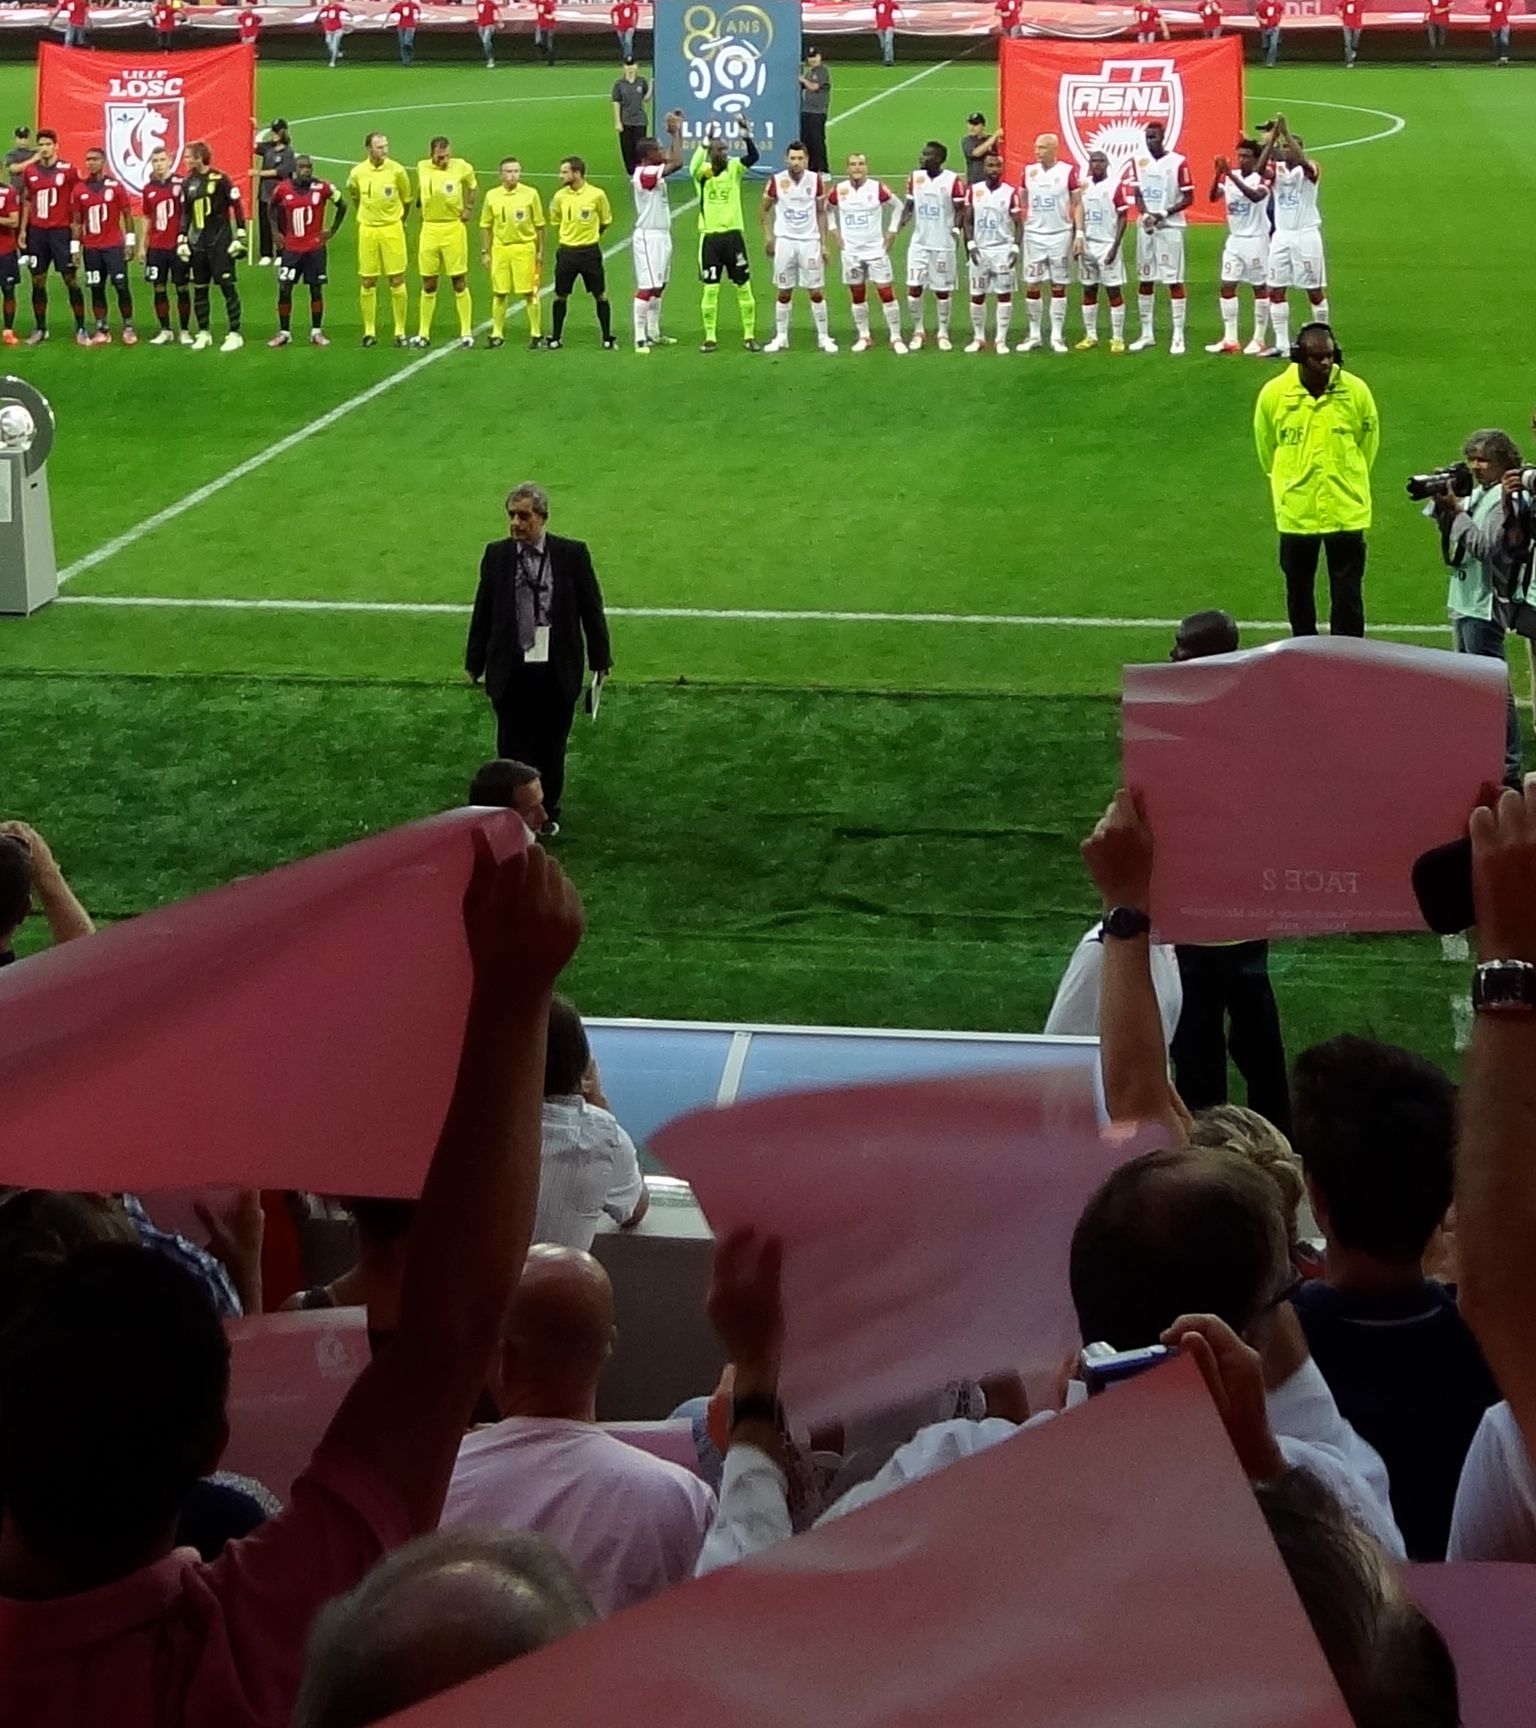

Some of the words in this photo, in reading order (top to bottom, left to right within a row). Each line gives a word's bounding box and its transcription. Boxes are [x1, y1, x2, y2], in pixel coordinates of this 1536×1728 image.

[726, 20, 760, 33] ANS
[122, 70, 168, 79] LILLE
[109, 78, 184, 97] LOSC
[1073, 87, 1170, 111] ASNL
[87, 270, 100, 284] 18
[280, 267, 296, 280] 24
